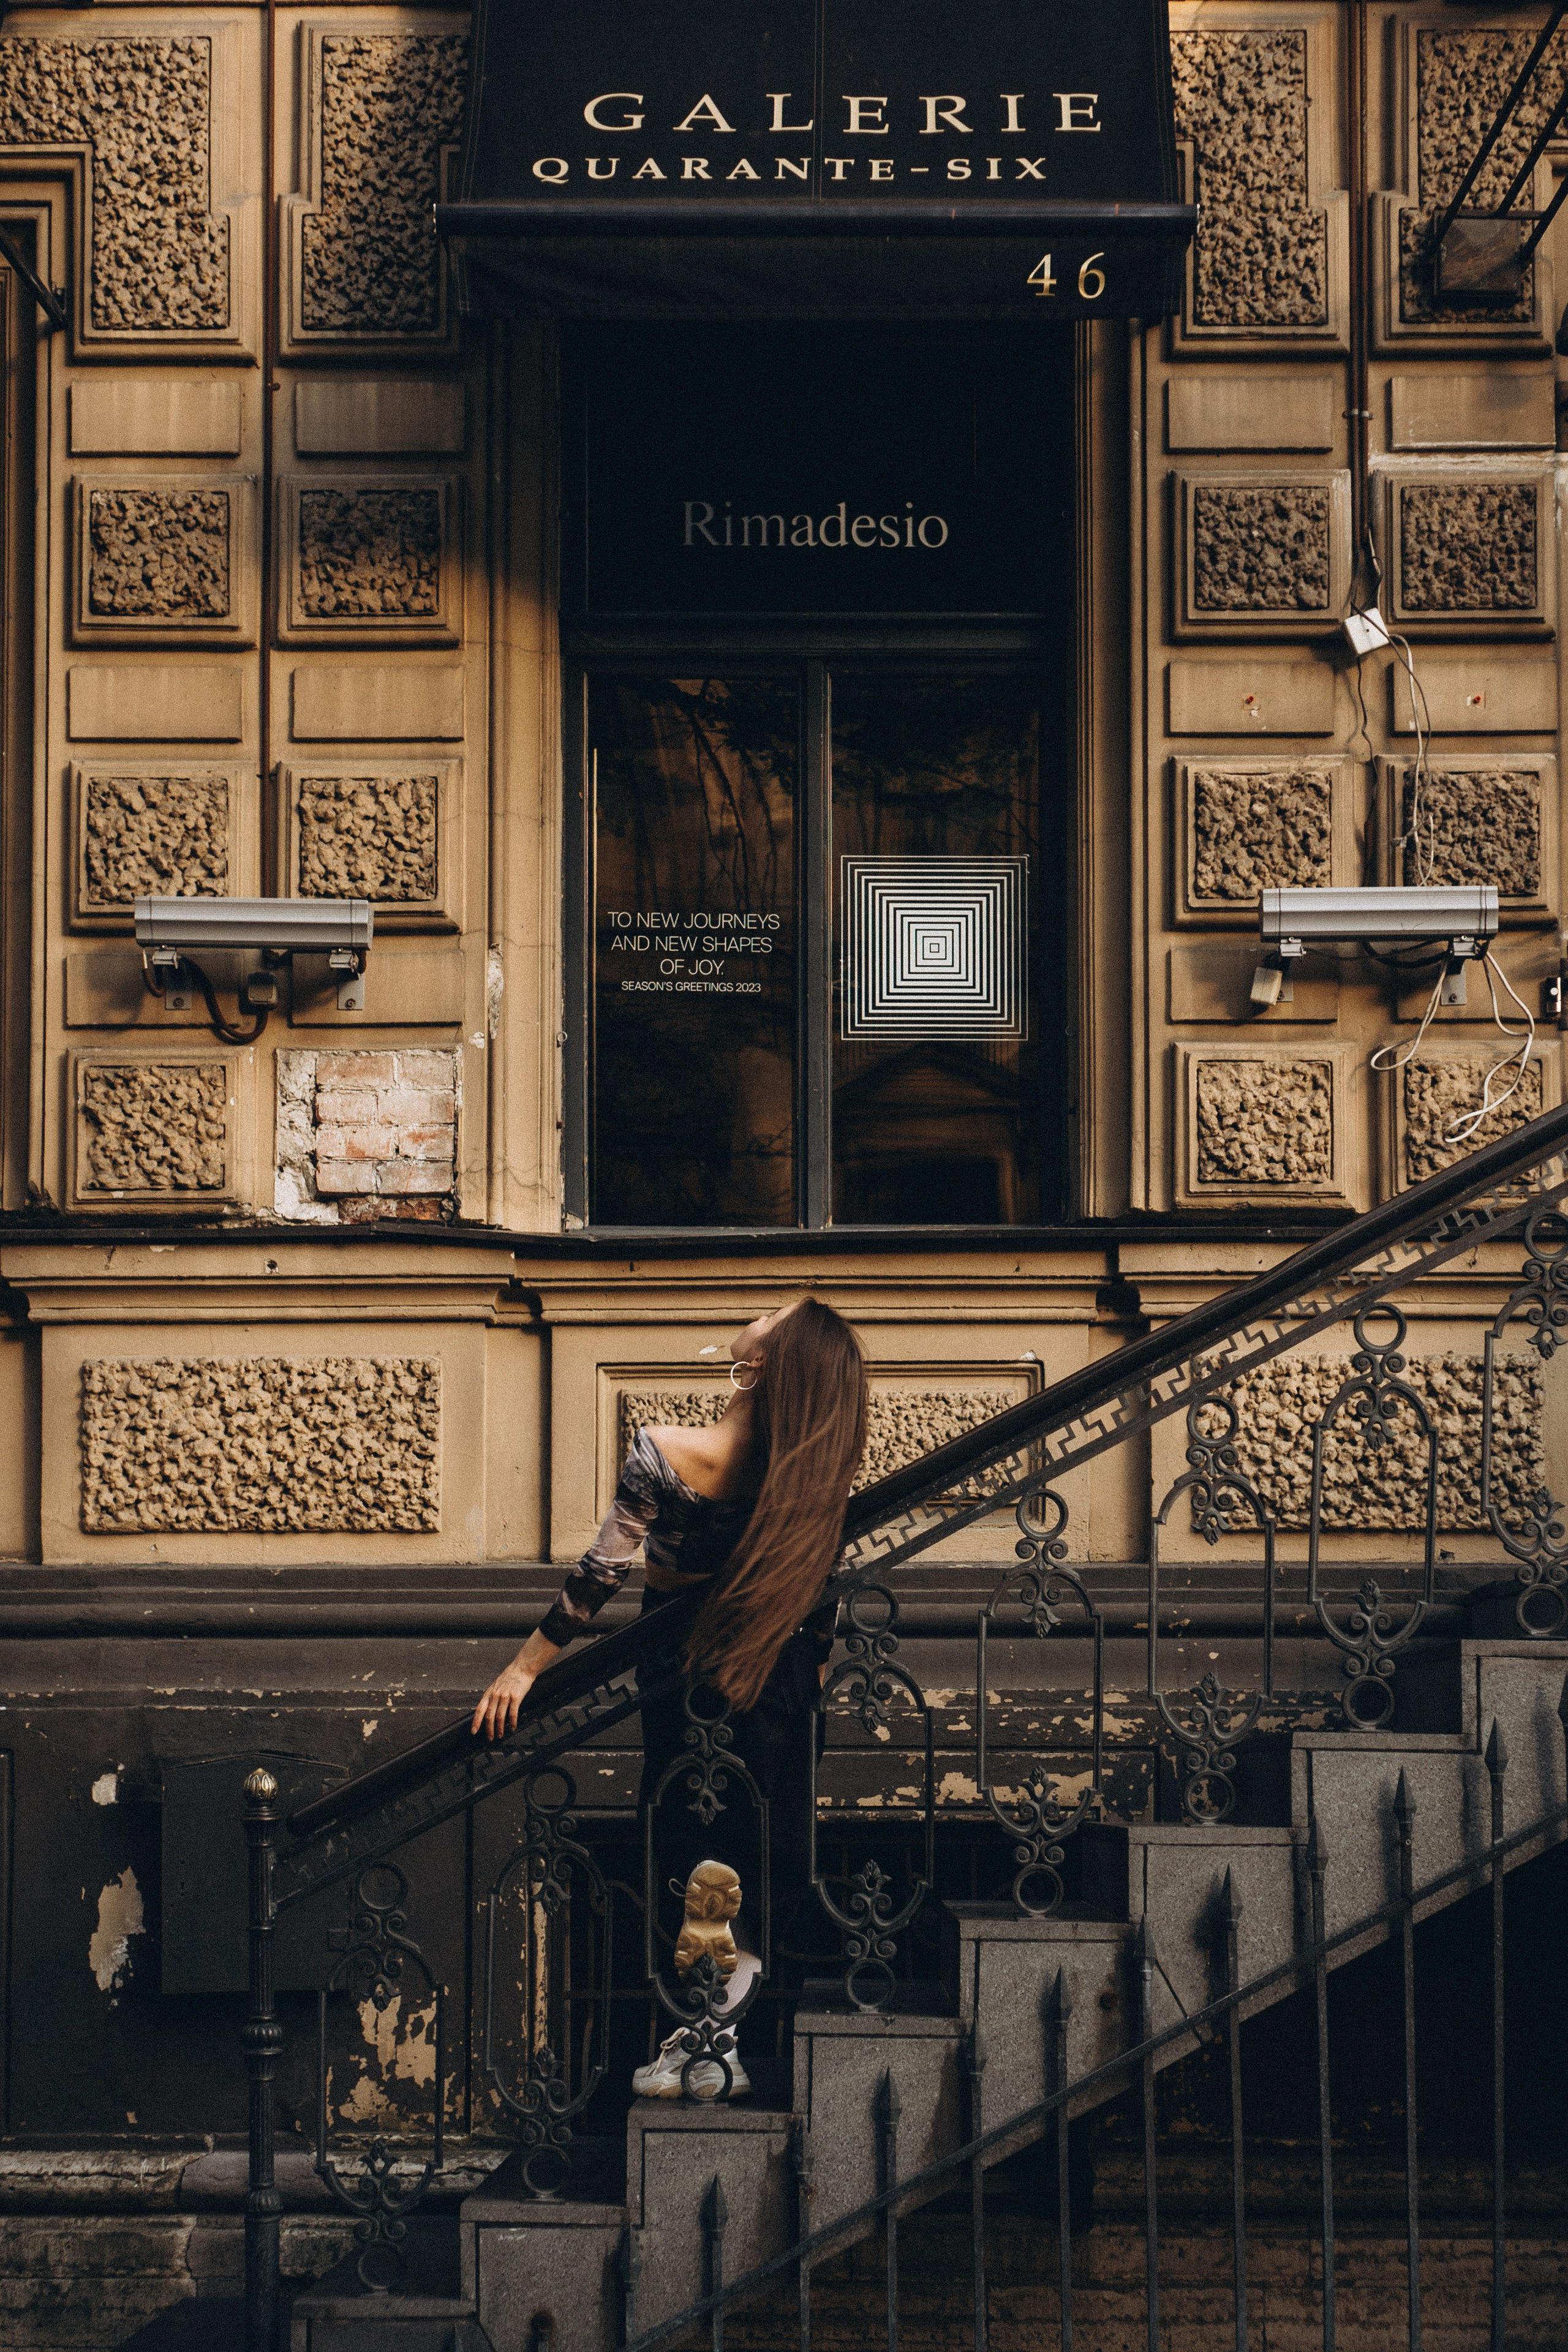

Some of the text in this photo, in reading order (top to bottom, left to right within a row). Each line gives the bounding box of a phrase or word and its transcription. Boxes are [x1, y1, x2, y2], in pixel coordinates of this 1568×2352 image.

[584, 92, 1101, 134] GALERIE
[532, 157, 1046, 184] QUARANTE-SIX
[1027, 252, 1105, 300] 46
[683, 501, 948, 548] Rimadesio
[608, 911, 780, 930] TO NEW JOURNEYS
[611, 935, 772, 953] AND NEW SHAPES
[660, 958, 725, 976] OF JOY.
[622, 981, 761, 992] SEASON'S GREETINGS 2023
